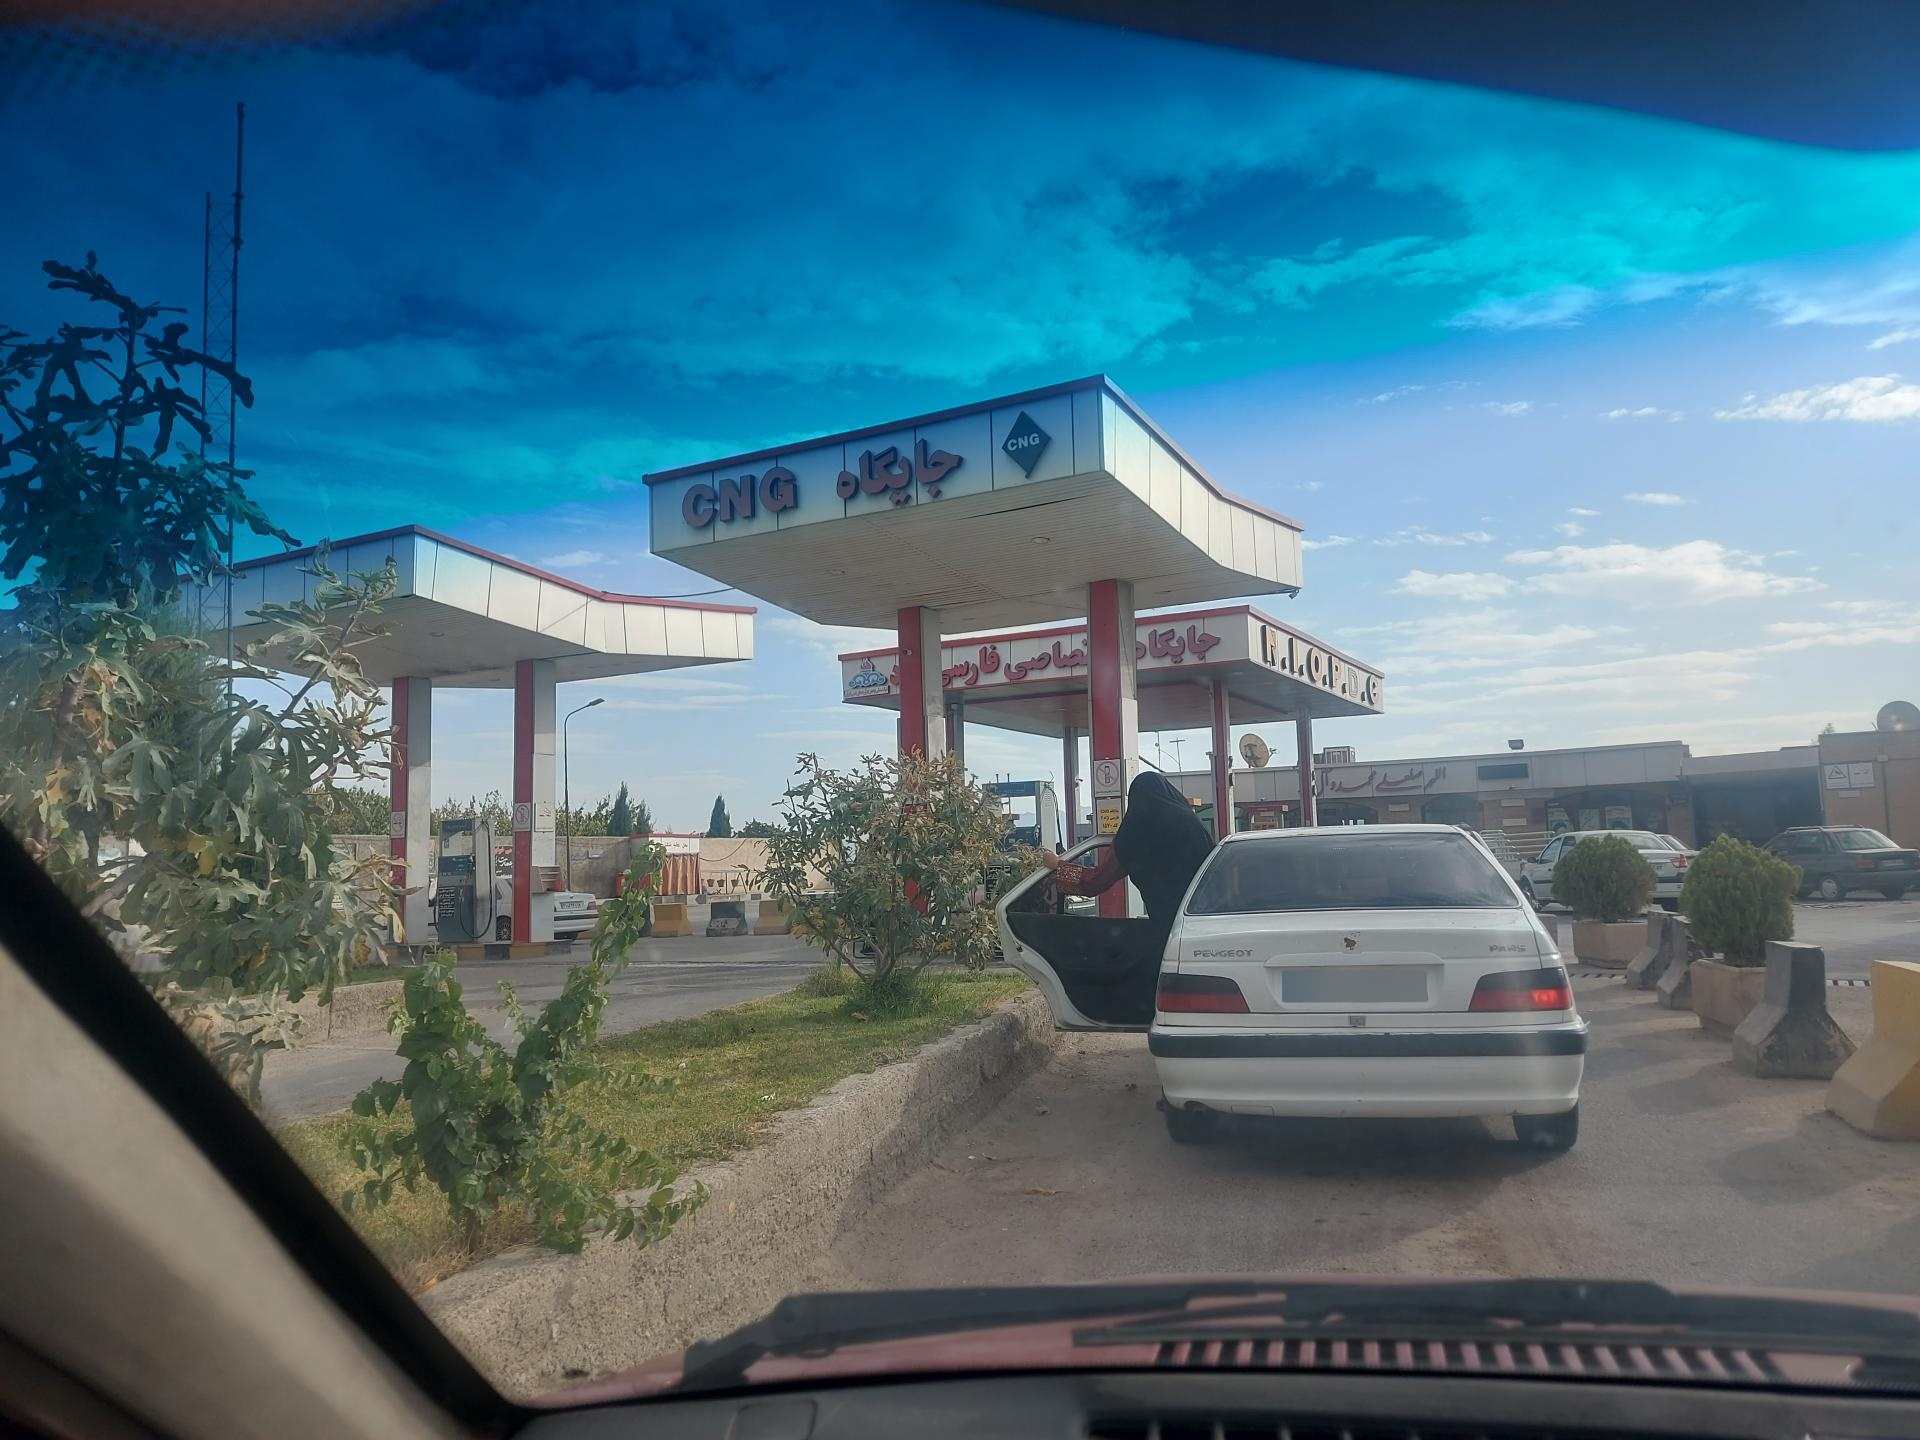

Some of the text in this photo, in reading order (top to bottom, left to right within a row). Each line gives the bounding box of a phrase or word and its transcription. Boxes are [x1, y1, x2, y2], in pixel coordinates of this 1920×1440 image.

[1007, 433, 1040, 451] CNG
[836, 438, 964, 506] جایگاه
[682, 466, 798, 528] CNG
[1193, 949, 1253, 958] PEUGEOT
